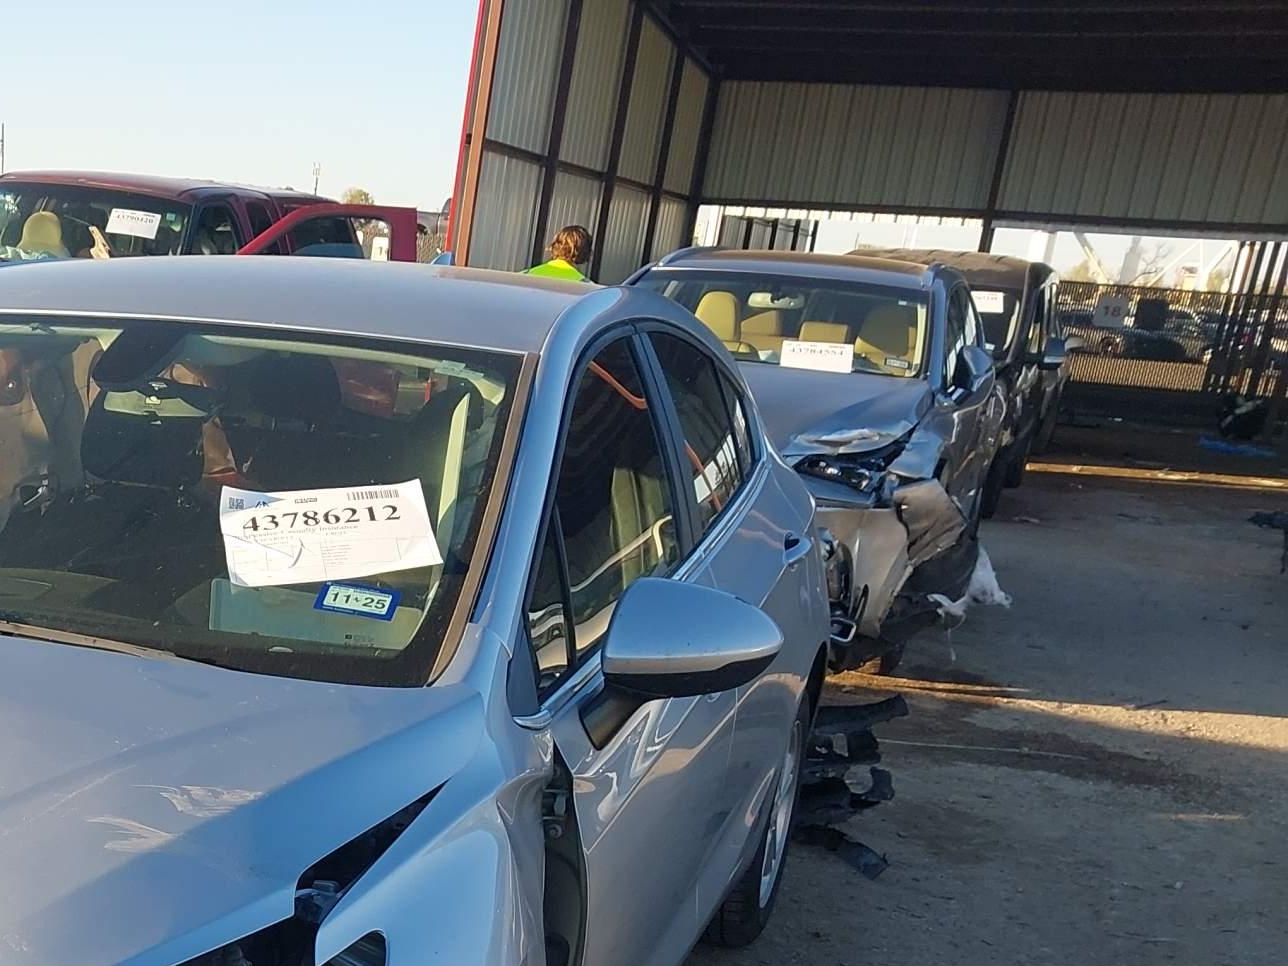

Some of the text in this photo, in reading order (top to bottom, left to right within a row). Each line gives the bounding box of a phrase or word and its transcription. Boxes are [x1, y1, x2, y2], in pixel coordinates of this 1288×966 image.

[1103, 305, 1121, 317] 18
[242, 503, 402, 532] 43786212
[330, 591, 352, 604] 11
[362, 597, 388, 610] 25
